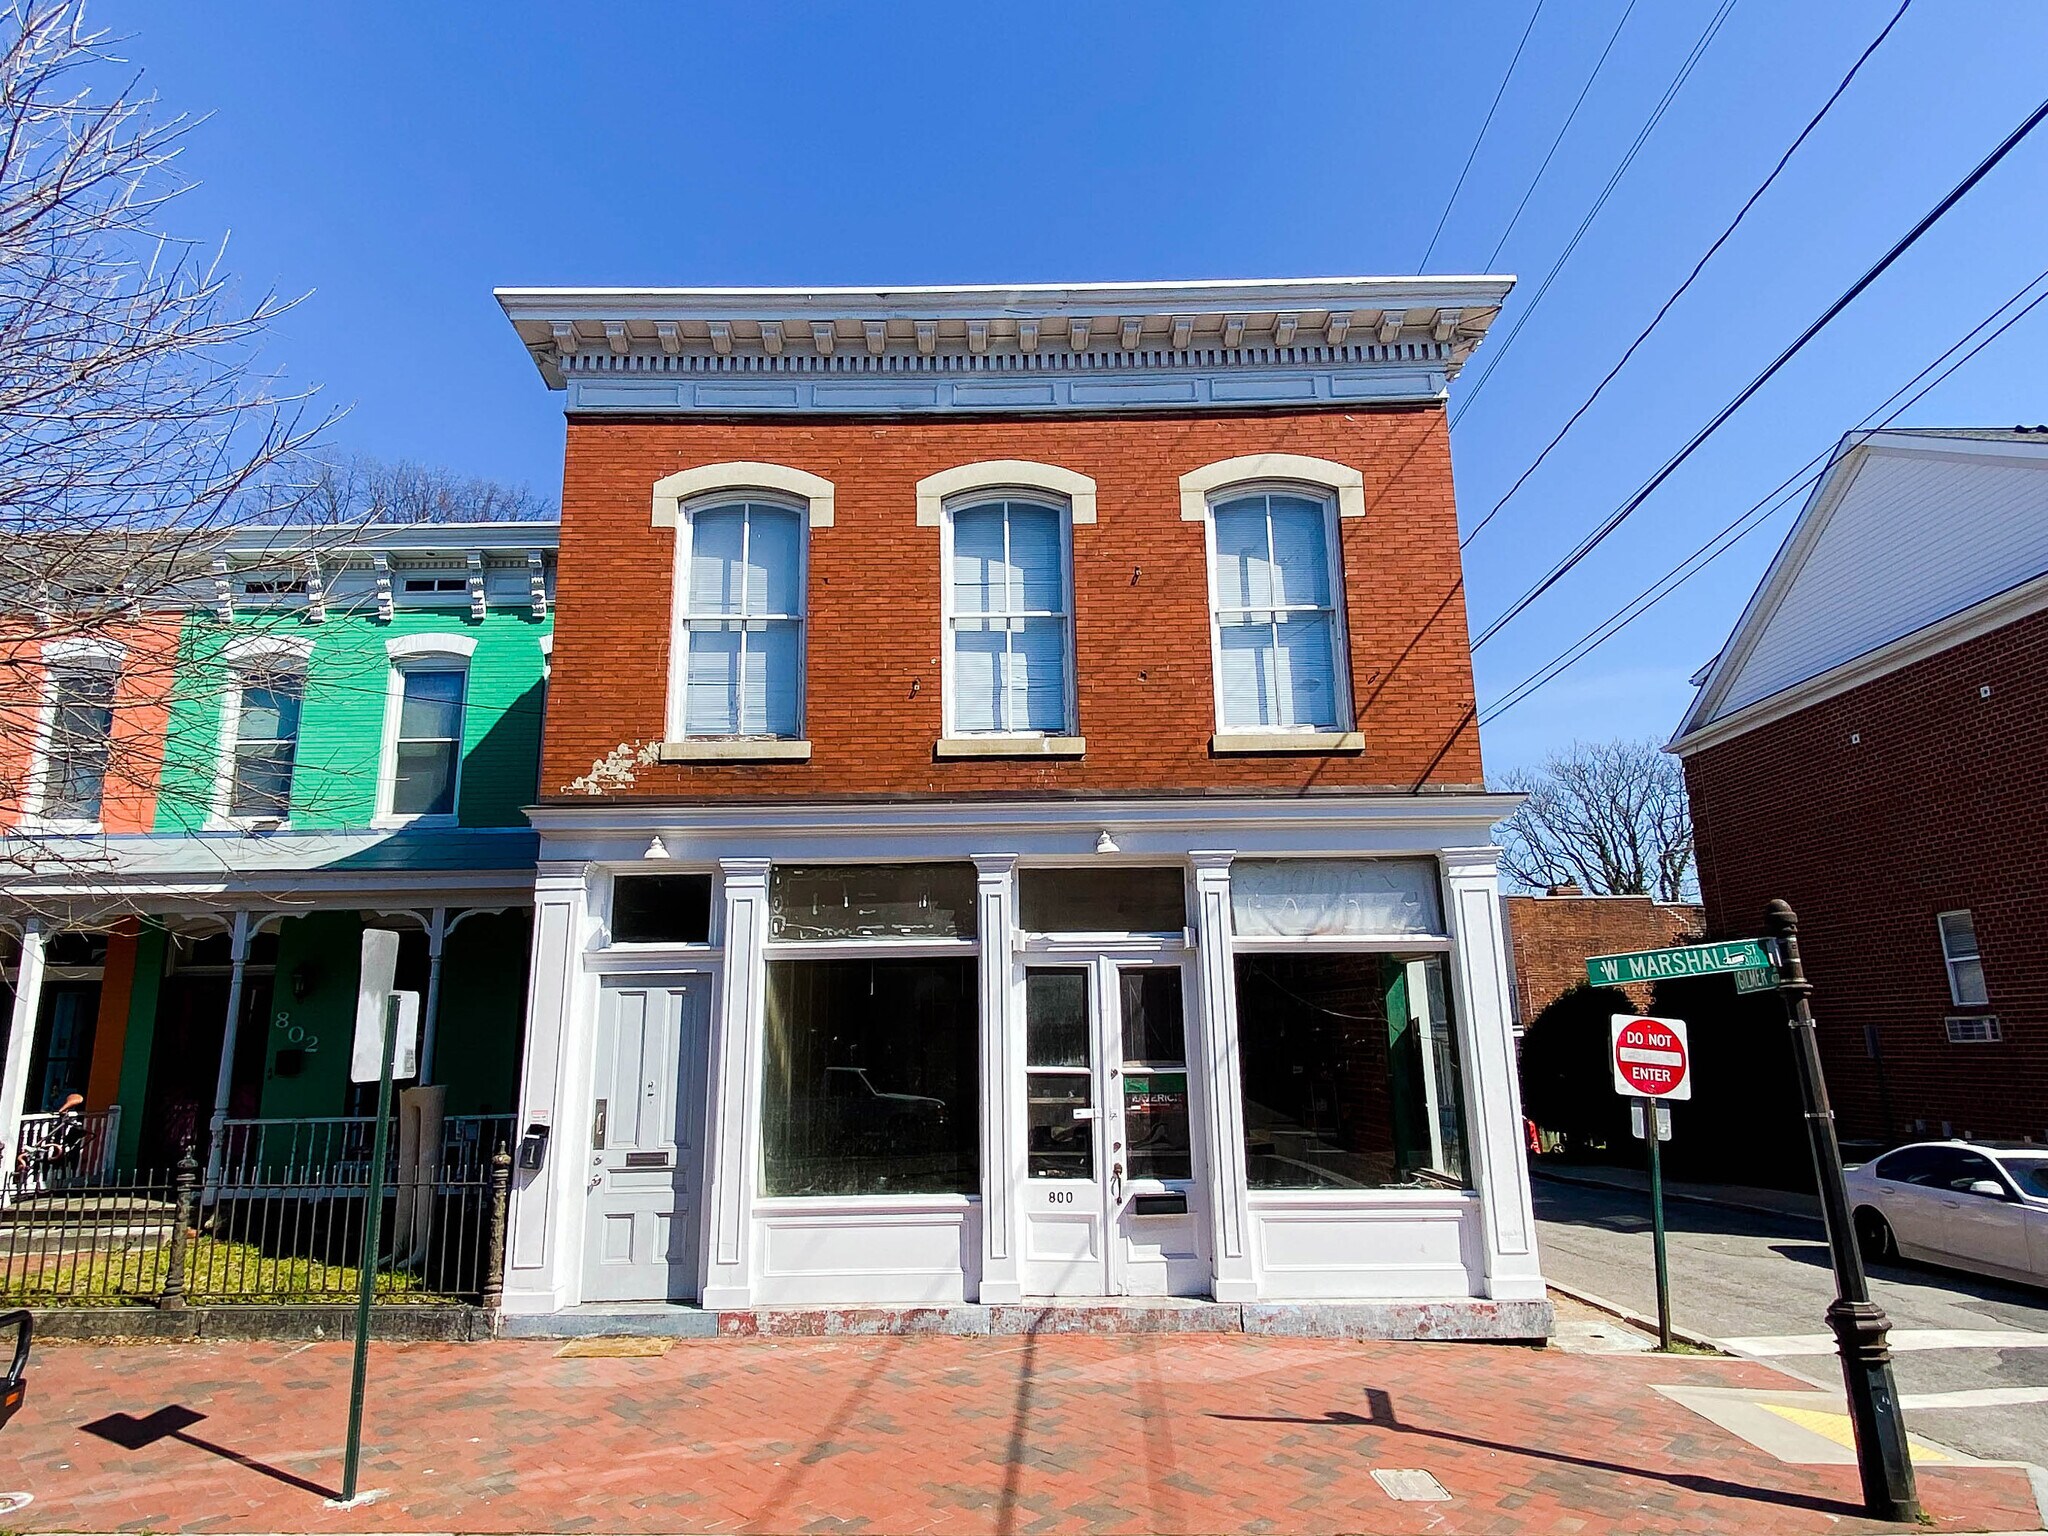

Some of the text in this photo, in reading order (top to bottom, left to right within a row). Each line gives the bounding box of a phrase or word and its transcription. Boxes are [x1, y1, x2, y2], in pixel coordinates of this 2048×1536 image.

[1602, 959, 1619, 982] W
[1629, 947, 1738, 979] MARSHALL
[1744, 944, 1757, 956] ST
[1737, 967, 1768, 990] GILMER
[275, 1011, 319, 1053] 802
[1626, 1031, 1673, 1047] DO NOT
[1632, 1066, 1671, 1082] ENTER
[1048, 1191, 1073, 1204] 800
